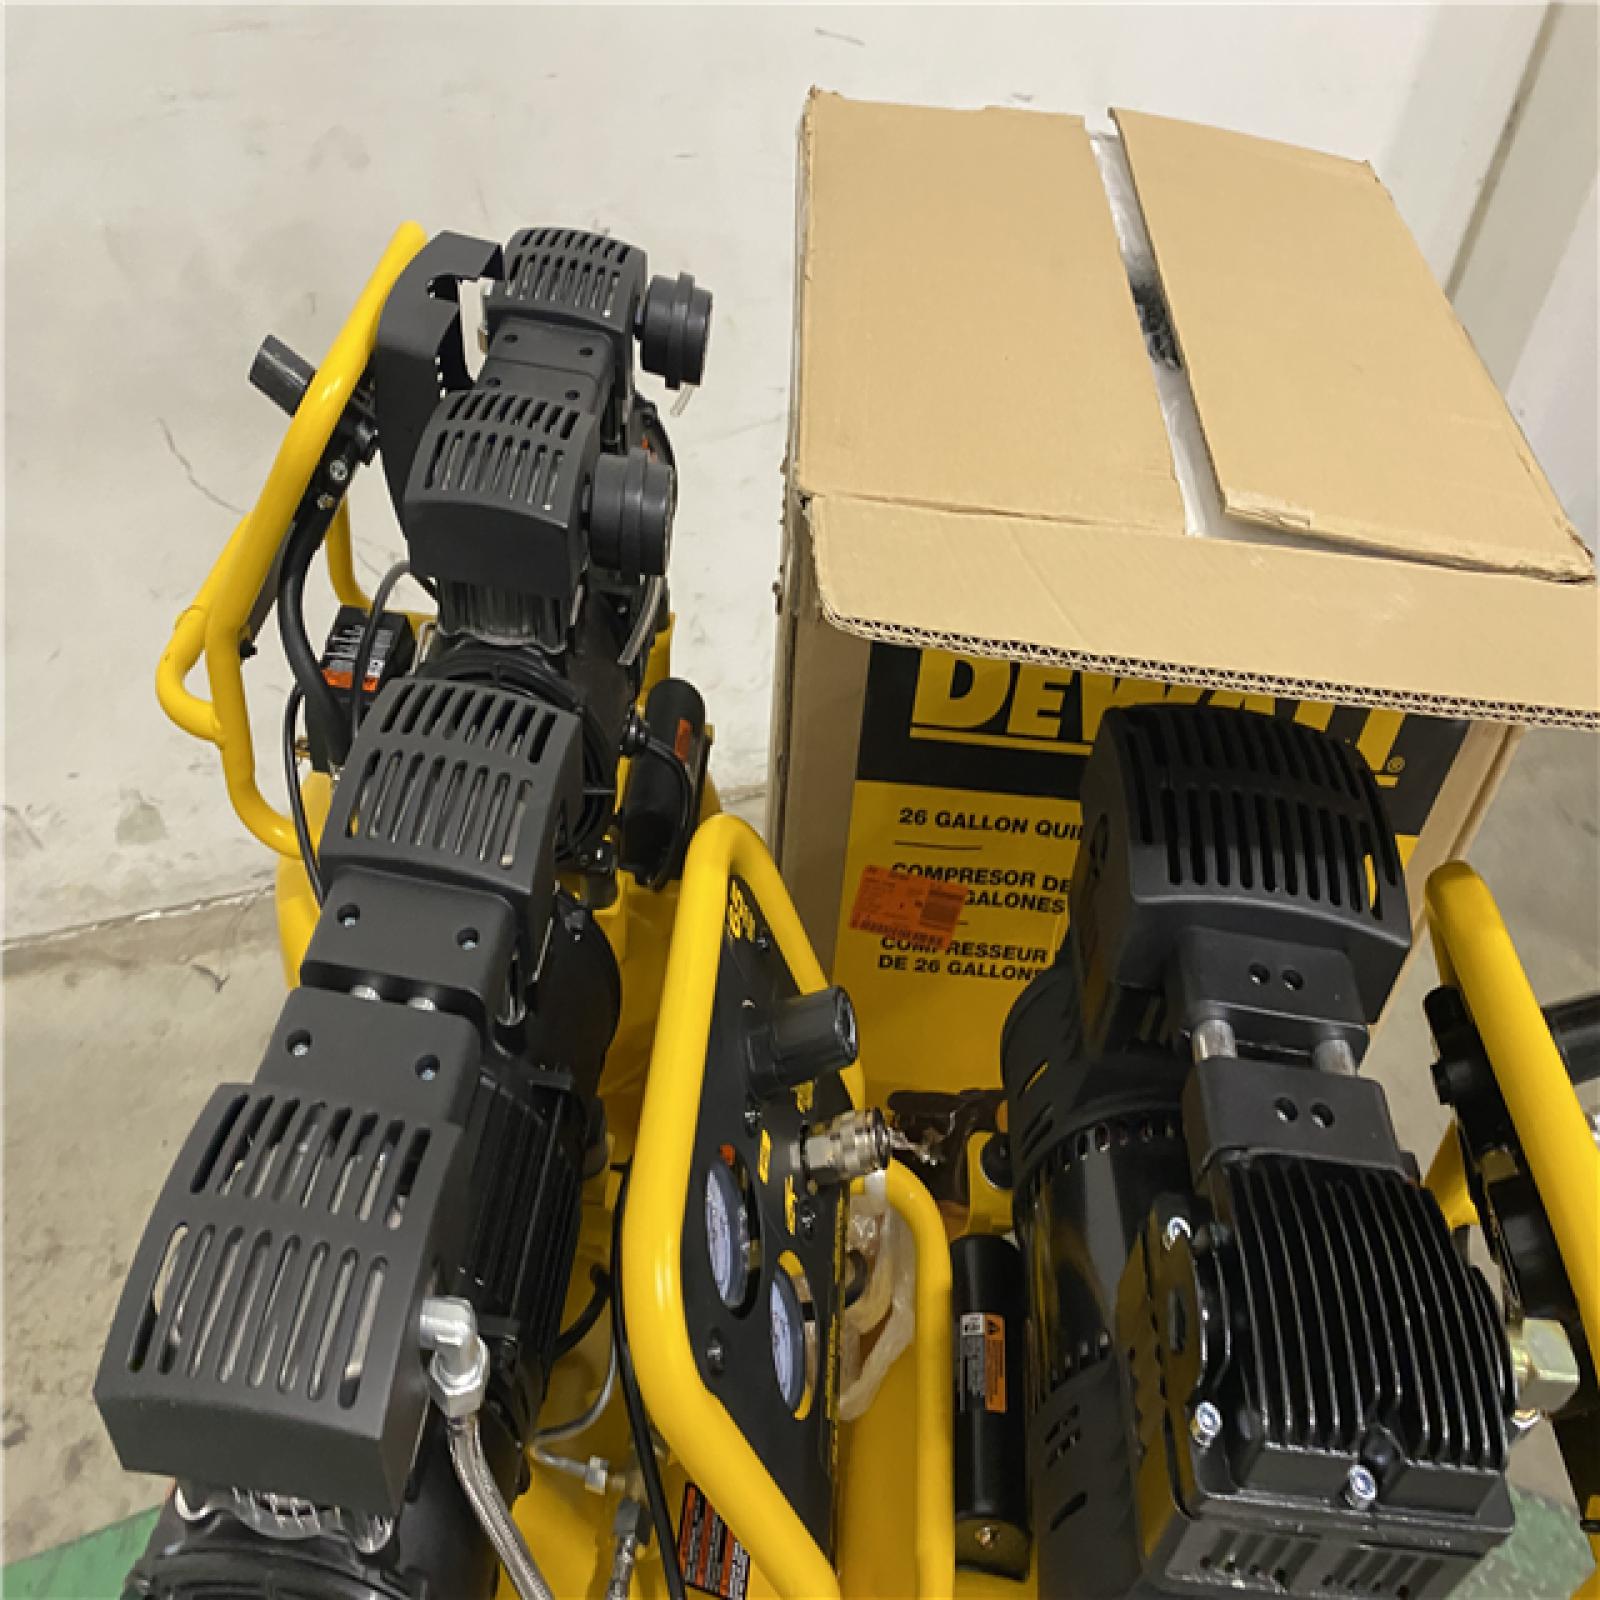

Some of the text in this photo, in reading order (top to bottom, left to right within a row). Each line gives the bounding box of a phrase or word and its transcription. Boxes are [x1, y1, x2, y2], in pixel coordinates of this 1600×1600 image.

[898, 807, 928, 825] 26
[934, 810, 1029, 833] GALLON
[891, 862, 1072, 893] COMPRESOR DE
[880, 934, 1048, 964] CORESSEUR
[877, 954, 908, 971] DE
[914, 957, 941, 973] 26
